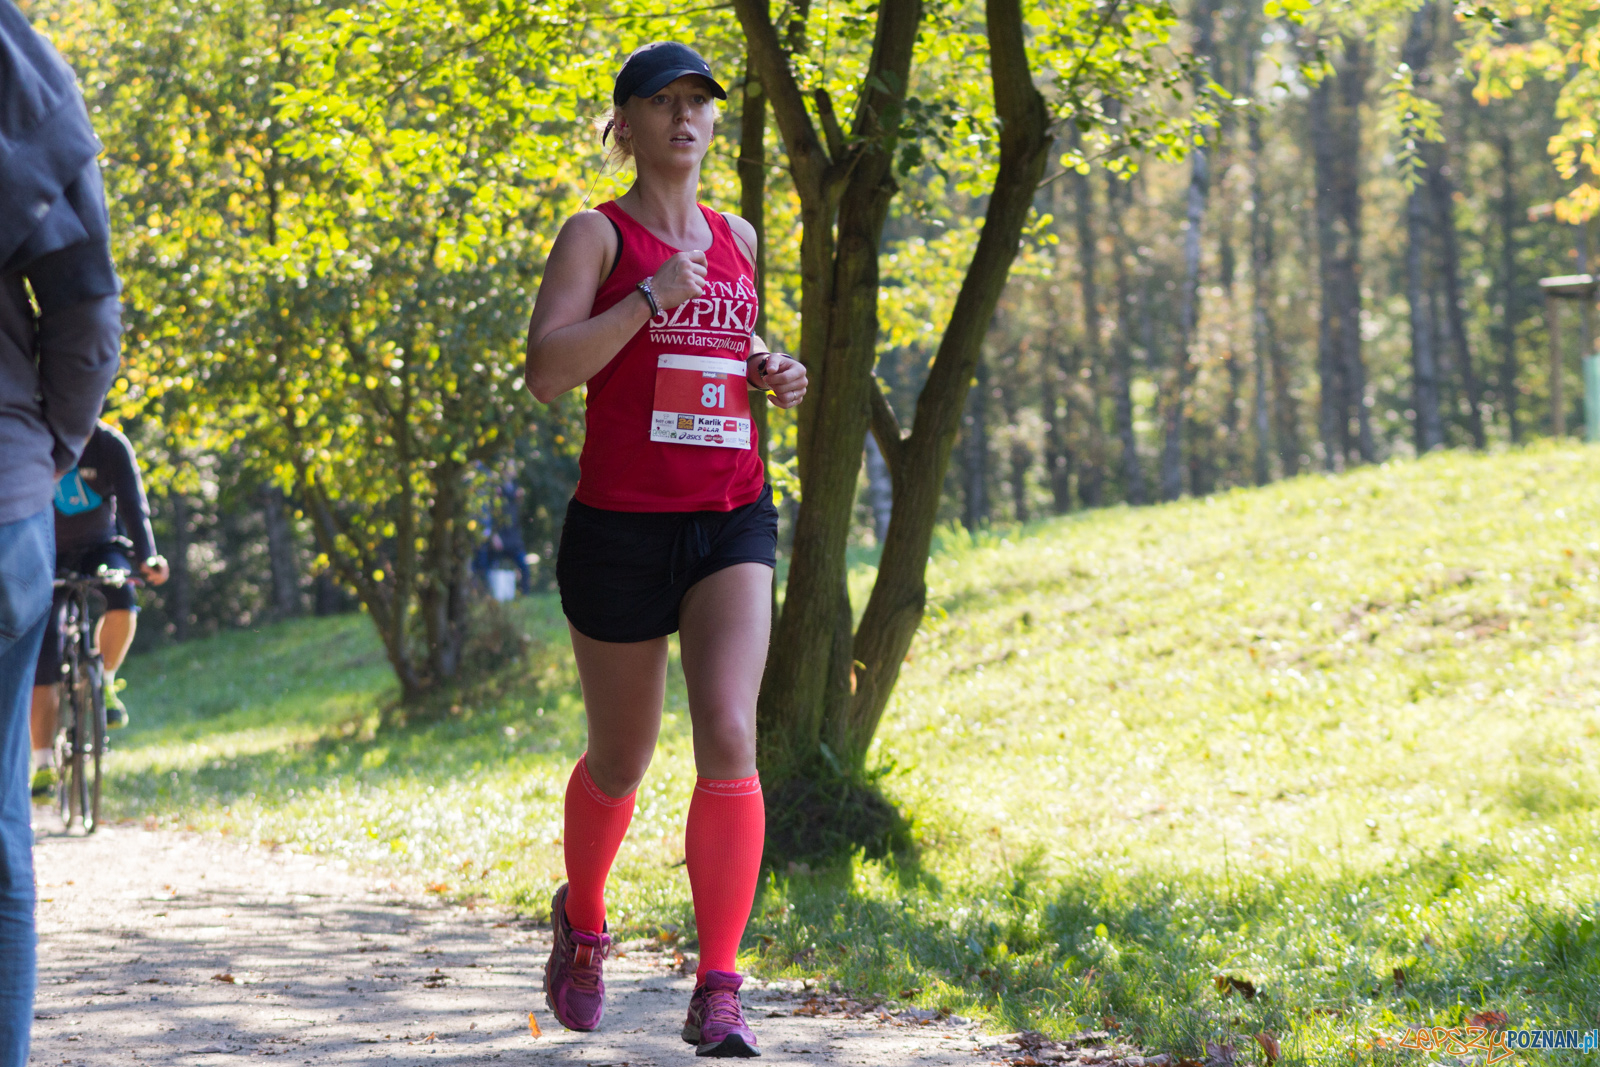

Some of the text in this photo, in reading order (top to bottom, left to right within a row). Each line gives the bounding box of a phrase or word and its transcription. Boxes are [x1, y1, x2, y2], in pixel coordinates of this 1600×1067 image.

[702, 280, 749, 300] YNA
[650, 333, 746, 353] www.darszpiku.pl
[701, 383, 725, 408] 81
[698, 417, 722, 427] Karlik
[708, 780, 752, 789] CRAFT
